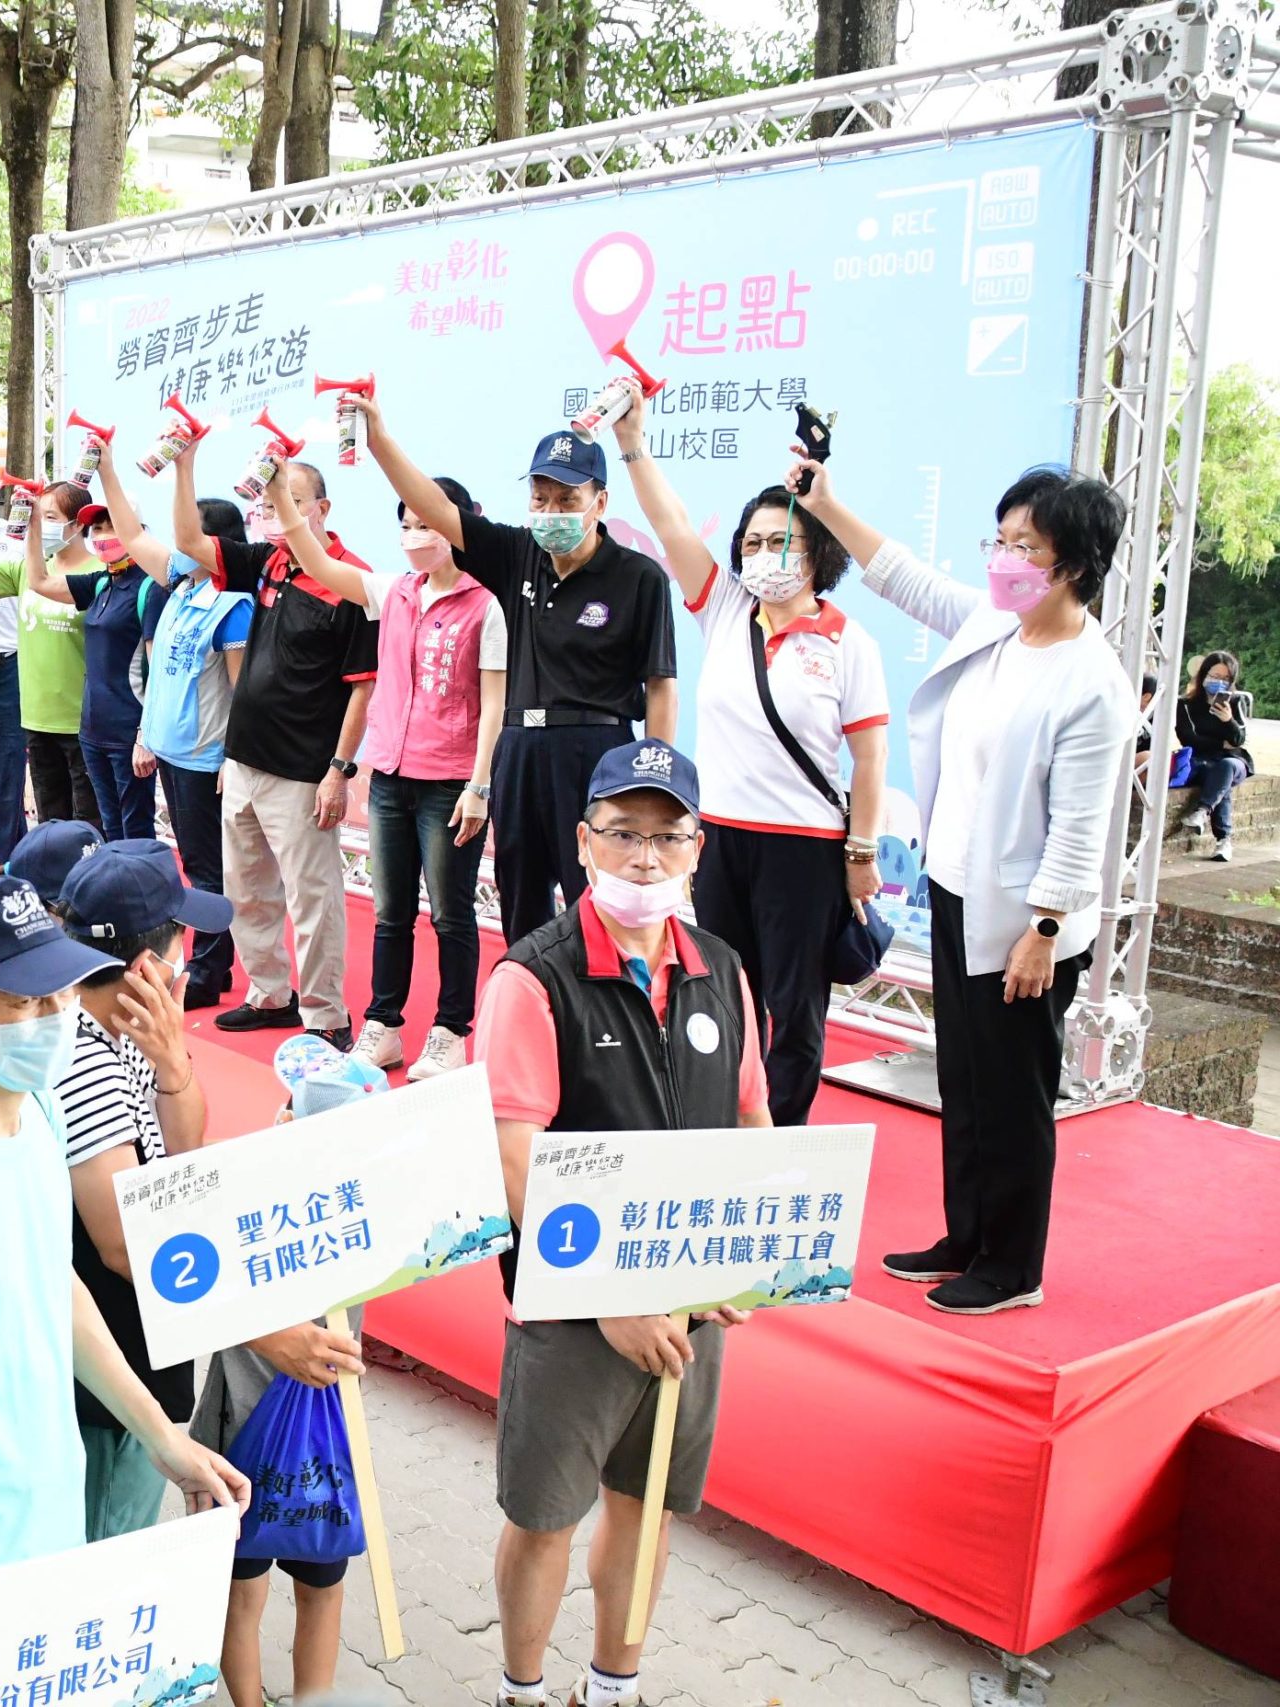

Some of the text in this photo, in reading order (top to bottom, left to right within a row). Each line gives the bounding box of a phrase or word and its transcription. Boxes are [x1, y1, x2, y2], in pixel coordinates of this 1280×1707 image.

[891, 208, 937, 237] REC
[982, 202, 1032, 223] AUTO
[394, 239, 509, 296] 美好彰化
[833, 248, 935, 281] 00:00:00
[988, 250, 1020, 270] ISO
[976, 277, 1028, 298] AUTO
[125, 298, 171, 330] 2022
[408, 295, 505, 337] 希望城市
[658, 269, 812, 357] 起點
[115, 293, 265, 381] 勞資齊步走
[159, 324, 311, 411] 健康樂悠遊
[563, 377, 808, 417] 國化師範大學
[641, 428, 740, 460] 山校區
[533, 1142, 607, 1167] 勞資齊步走
[556, 1153, 625, 1177] 健康樂悠遊
[122, 1163, 196, 1209] 勞資齊步走
[150, 1169, 220, 1213] 健康樂悠遊
[235, 1179, 365, 1248] 聖久企業
[619, 1192, 844, 1232] 彰化縣旅行業務
[241, 1218, 372, 1288] 有限公司
[558, 1220, 577, 1252] 1
[615, 1230, 837, 1270] 服務人員職業工會
[170, 1251, 200, 1289] 2
[254, 1456, 344, 1498] 美好彰化
[260, 1500, 350, 1528] 希望城市
